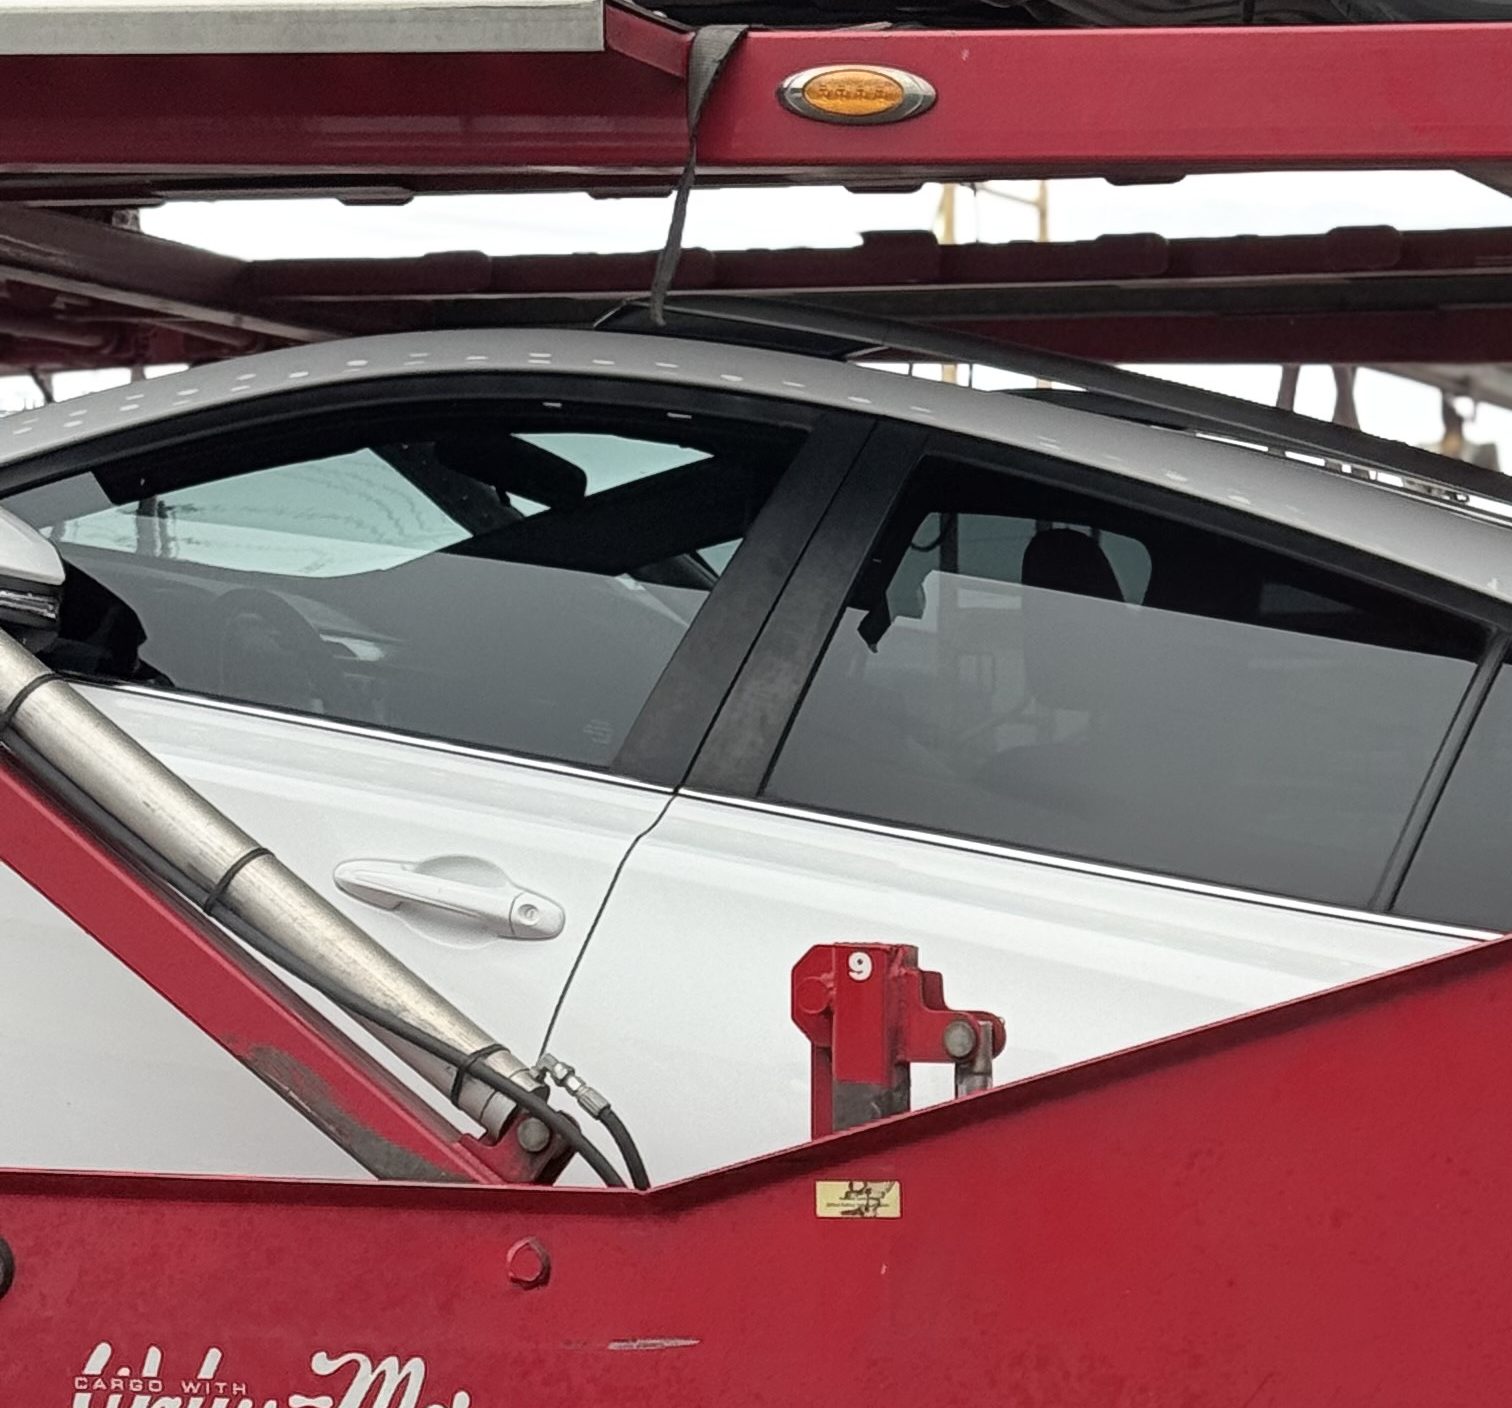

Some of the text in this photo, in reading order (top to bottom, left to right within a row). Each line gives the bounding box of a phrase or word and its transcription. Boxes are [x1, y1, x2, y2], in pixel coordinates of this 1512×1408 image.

[848, 951, 873, 982] 9
[74, 1376, 247, 1395] CARGO WITH
